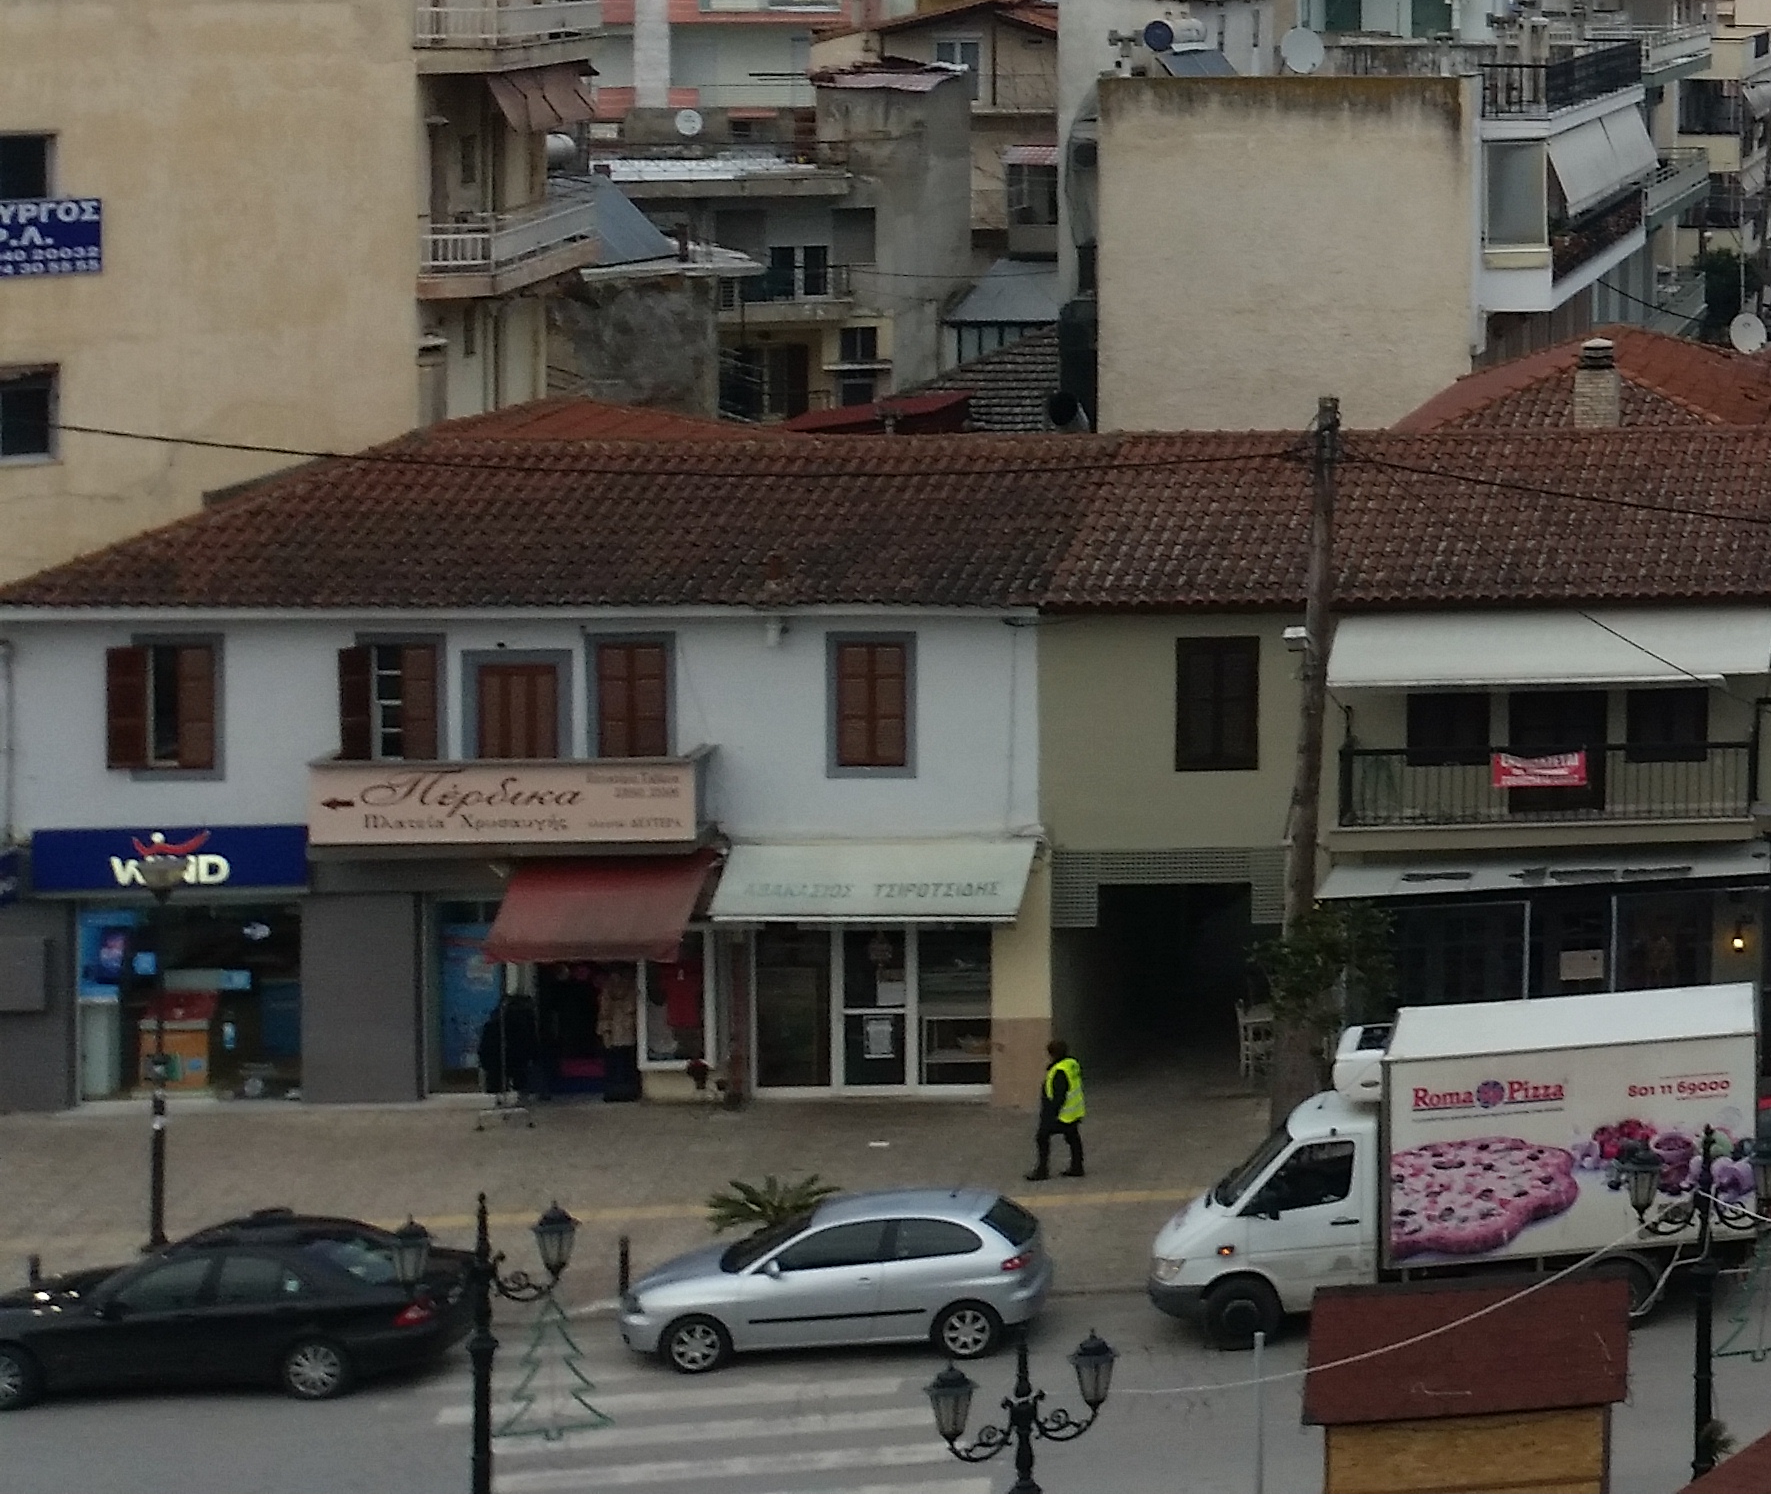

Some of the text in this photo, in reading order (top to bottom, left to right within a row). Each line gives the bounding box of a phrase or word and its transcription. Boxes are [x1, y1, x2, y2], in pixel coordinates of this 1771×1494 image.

[360, 768, 583, 818] Πέρδικα
[110, 853, 231, 886] WD
[1412, 1080, 1565, 1107] Roma Pizza
[1627, 1080, 1730, 1098] 801 11 69000
